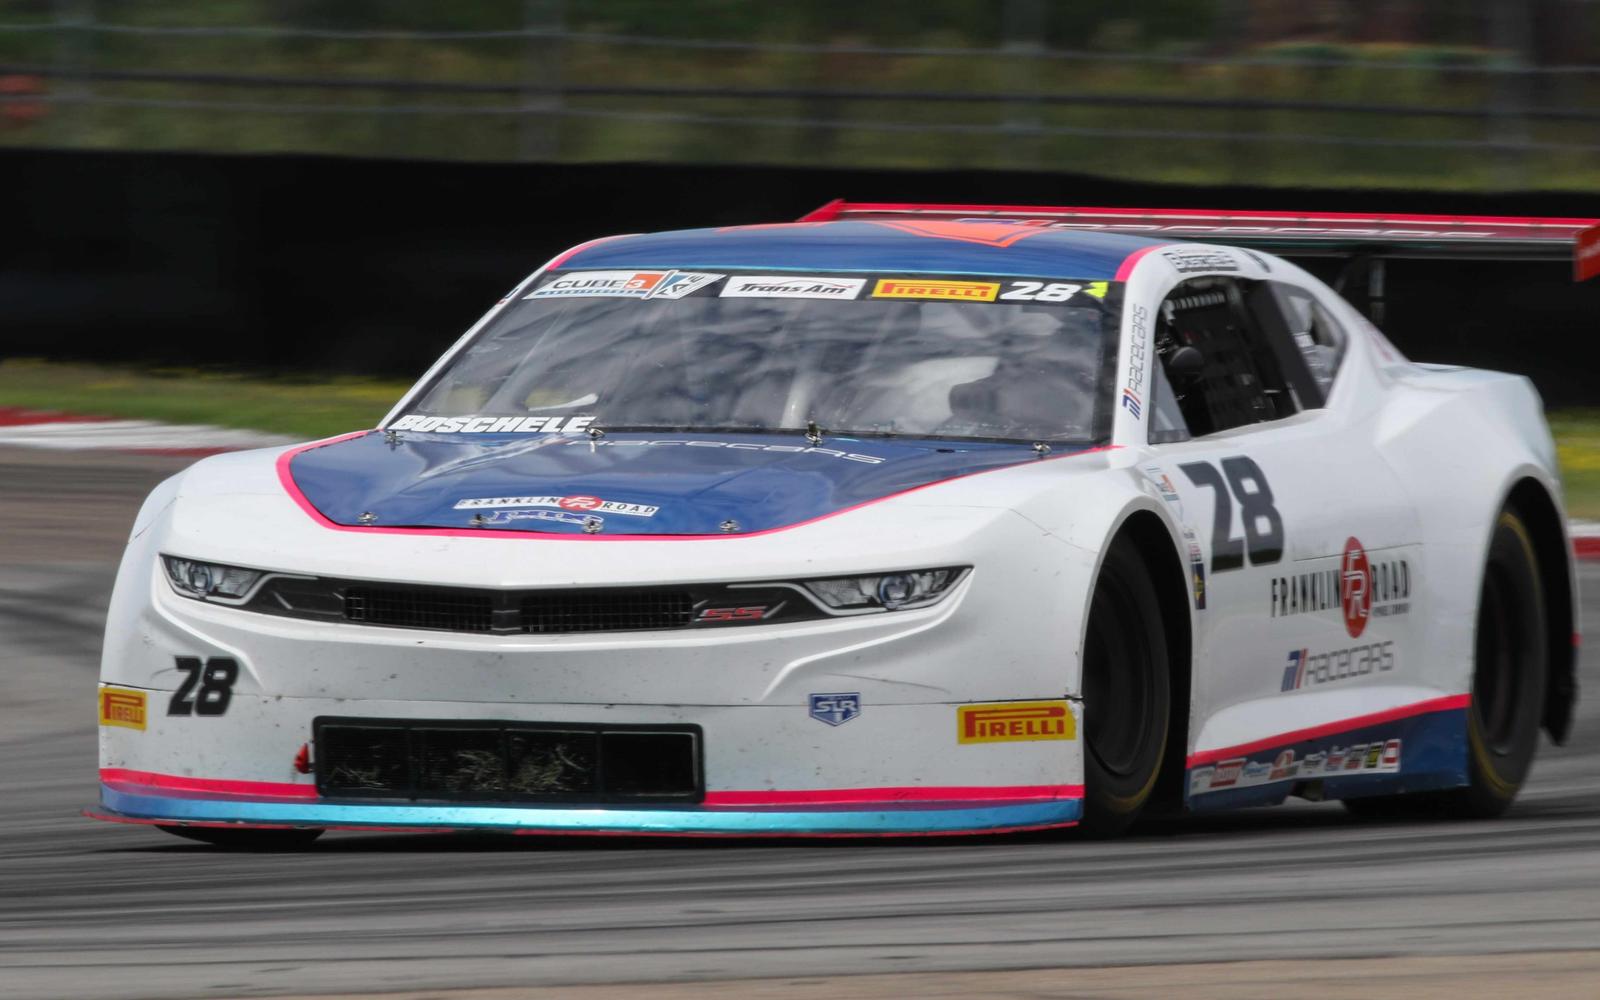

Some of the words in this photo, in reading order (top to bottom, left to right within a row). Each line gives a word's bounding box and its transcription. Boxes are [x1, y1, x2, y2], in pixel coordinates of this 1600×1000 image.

[738, 283, 803, 293] Trans
[803, 284, 847, 294] Am
[881, 282, 994, 298] PIRELLI
[1000, 281, 1082, 302] 28
[387, 414, 596, 433] BOSCHELE
[456, 496, 557, 508] FRANKLIN
[601, 502, 656, 514] ROAD
[1177, 454, 1285, 575] 28
[1270, 569, 1341, 618] FRANKLIN
[1370, 560, 1412, 603] ROAD
[166, 655, 239, 717] 28
[103, 692, 144, 725] PIRELLI
[814, 700, 857, 712] SLR
[964, 706, 1066, 739] PIRELLI
